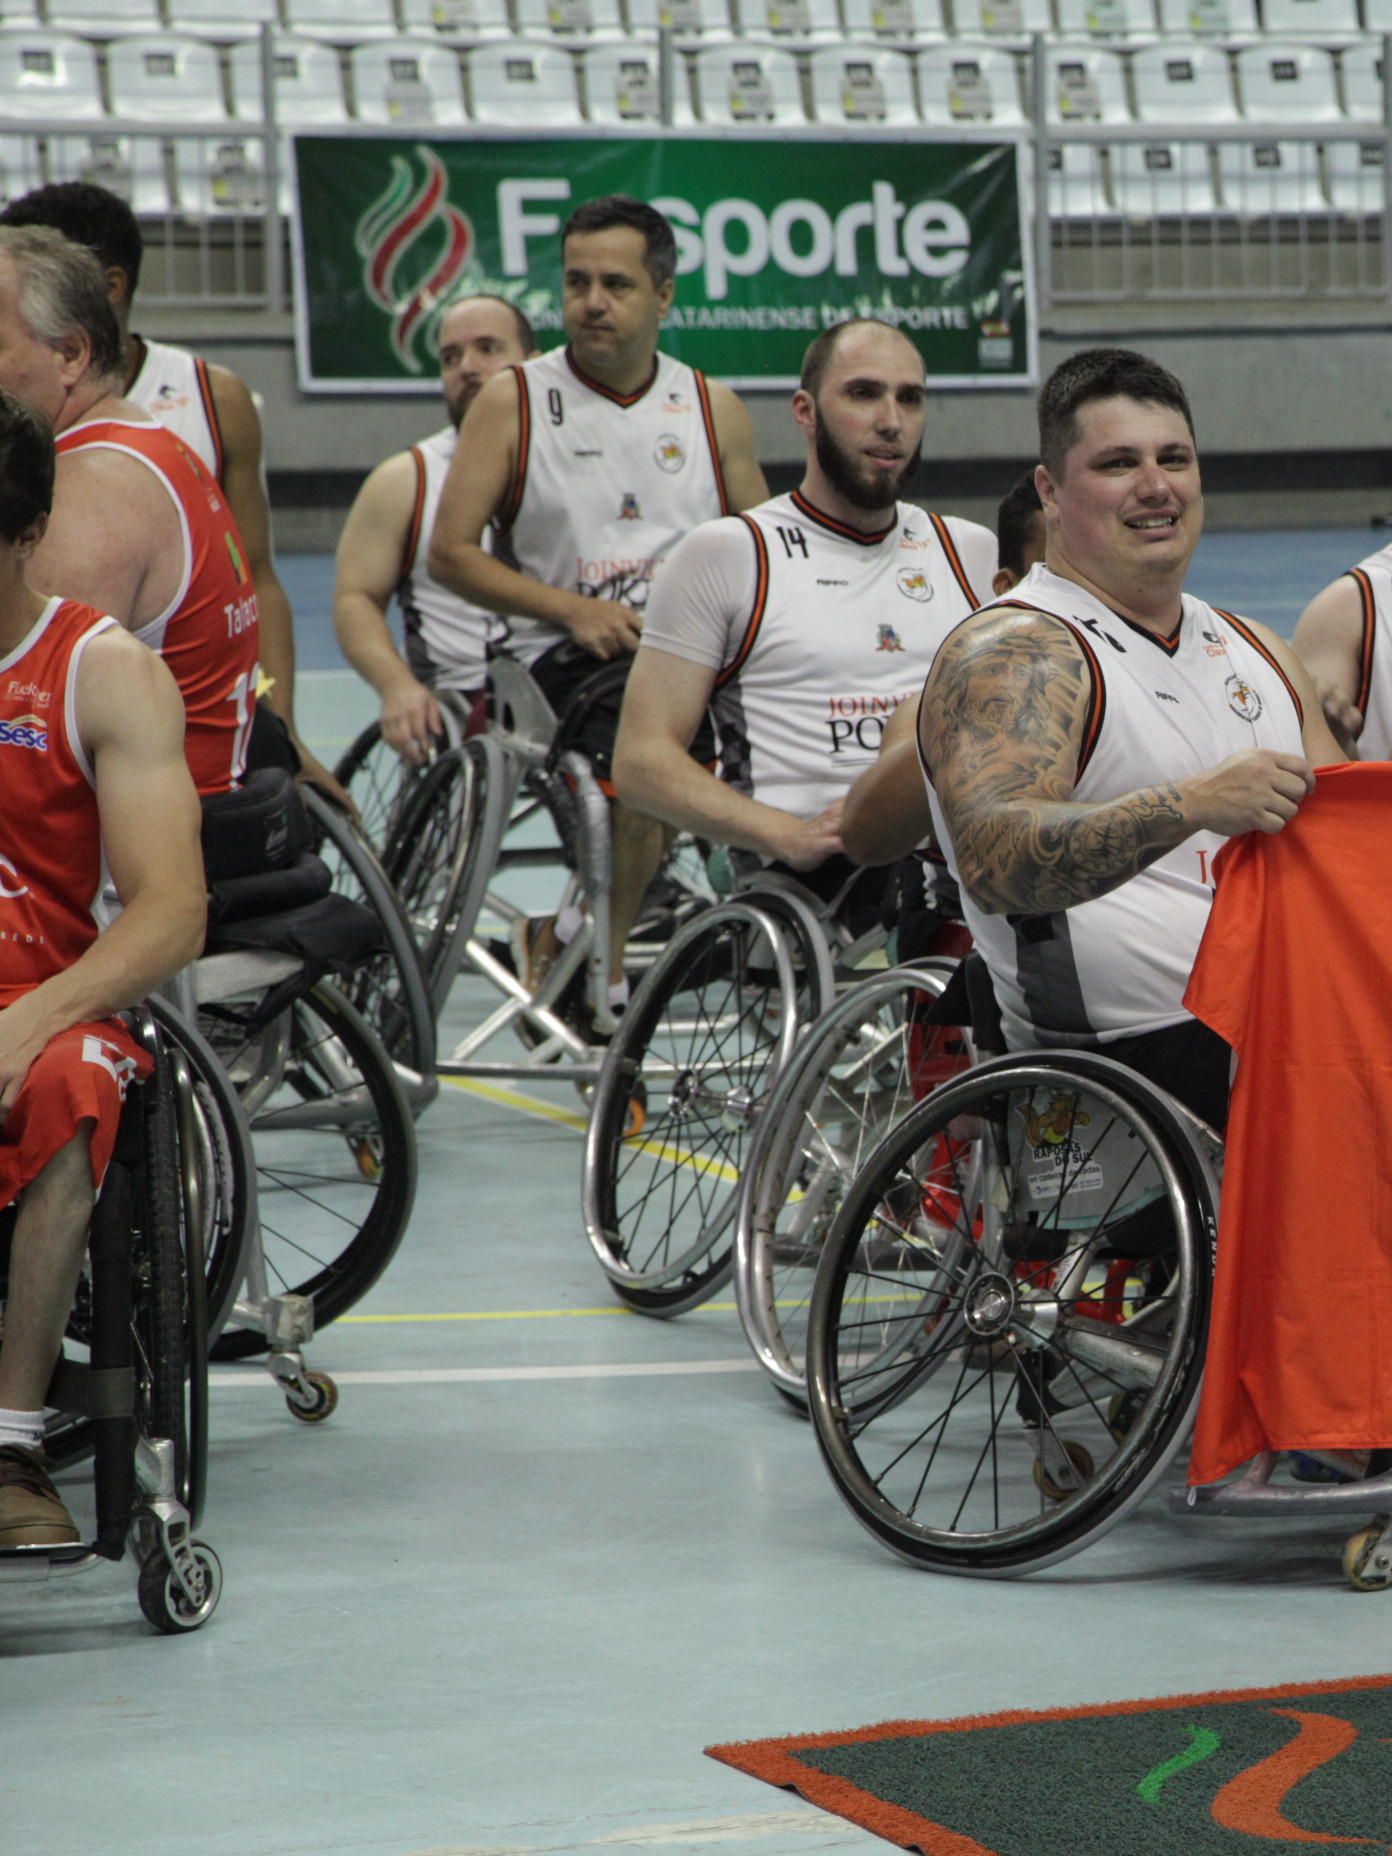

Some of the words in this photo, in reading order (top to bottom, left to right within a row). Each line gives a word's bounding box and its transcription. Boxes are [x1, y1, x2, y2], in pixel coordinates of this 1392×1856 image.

[496, 179, 972, 300] Fsporte
[548, 389, 563, 426] 9
[777, 526, 809, 558] 14
